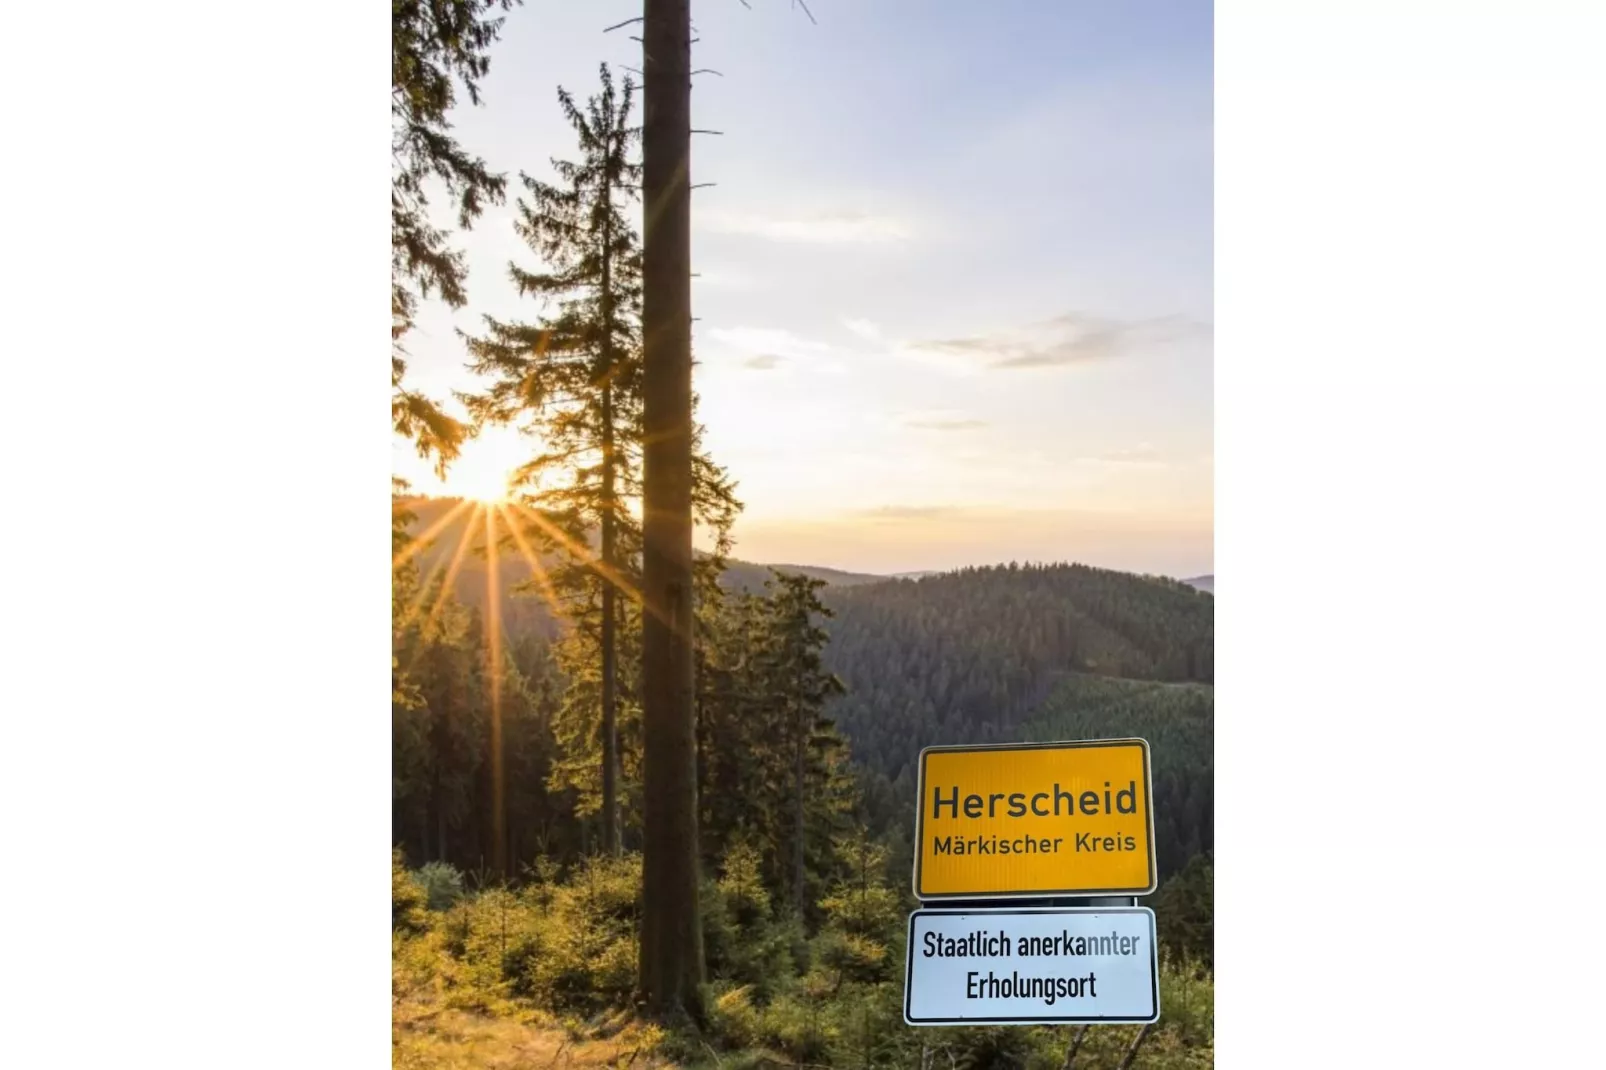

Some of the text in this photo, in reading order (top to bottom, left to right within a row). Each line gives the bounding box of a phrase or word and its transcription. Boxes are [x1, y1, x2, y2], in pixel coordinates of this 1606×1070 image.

[933, 780, 1138, 819] Herscheid
[933, 832, 1136, 856] Märkischer Kreis
[923, 929, 1140, 958] Staatlich anerkannter
[966, 971, 1097, 1005] Erholungsort
